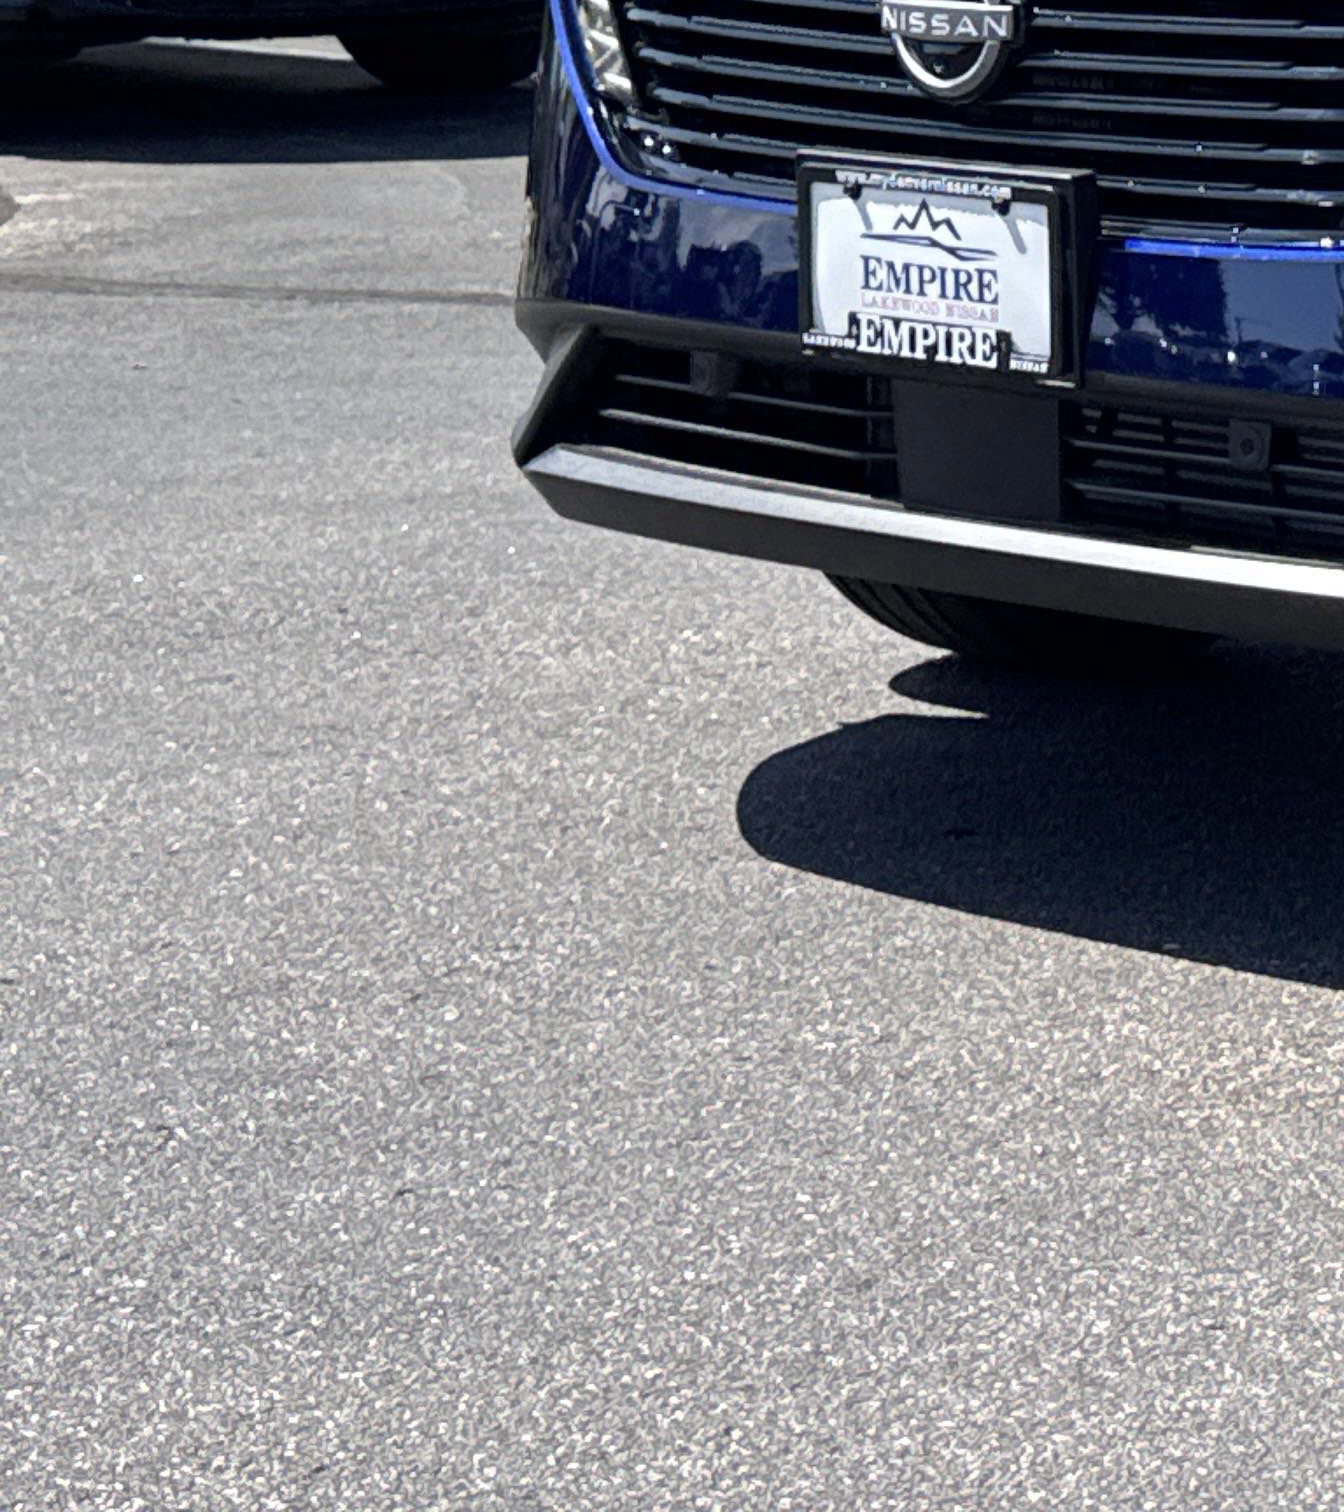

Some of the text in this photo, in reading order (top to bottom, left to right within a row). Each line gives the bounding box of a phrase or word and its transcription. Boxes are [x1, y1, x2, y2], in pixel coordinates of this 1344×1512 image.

[881, 4, 1008, 38] NISSAN
[860, 255, 998, 305] EMPIRE
[861, 291, 999, 323] LAKEWOOD NISSAN
[856, 313, 998, 369] EMPIRE
